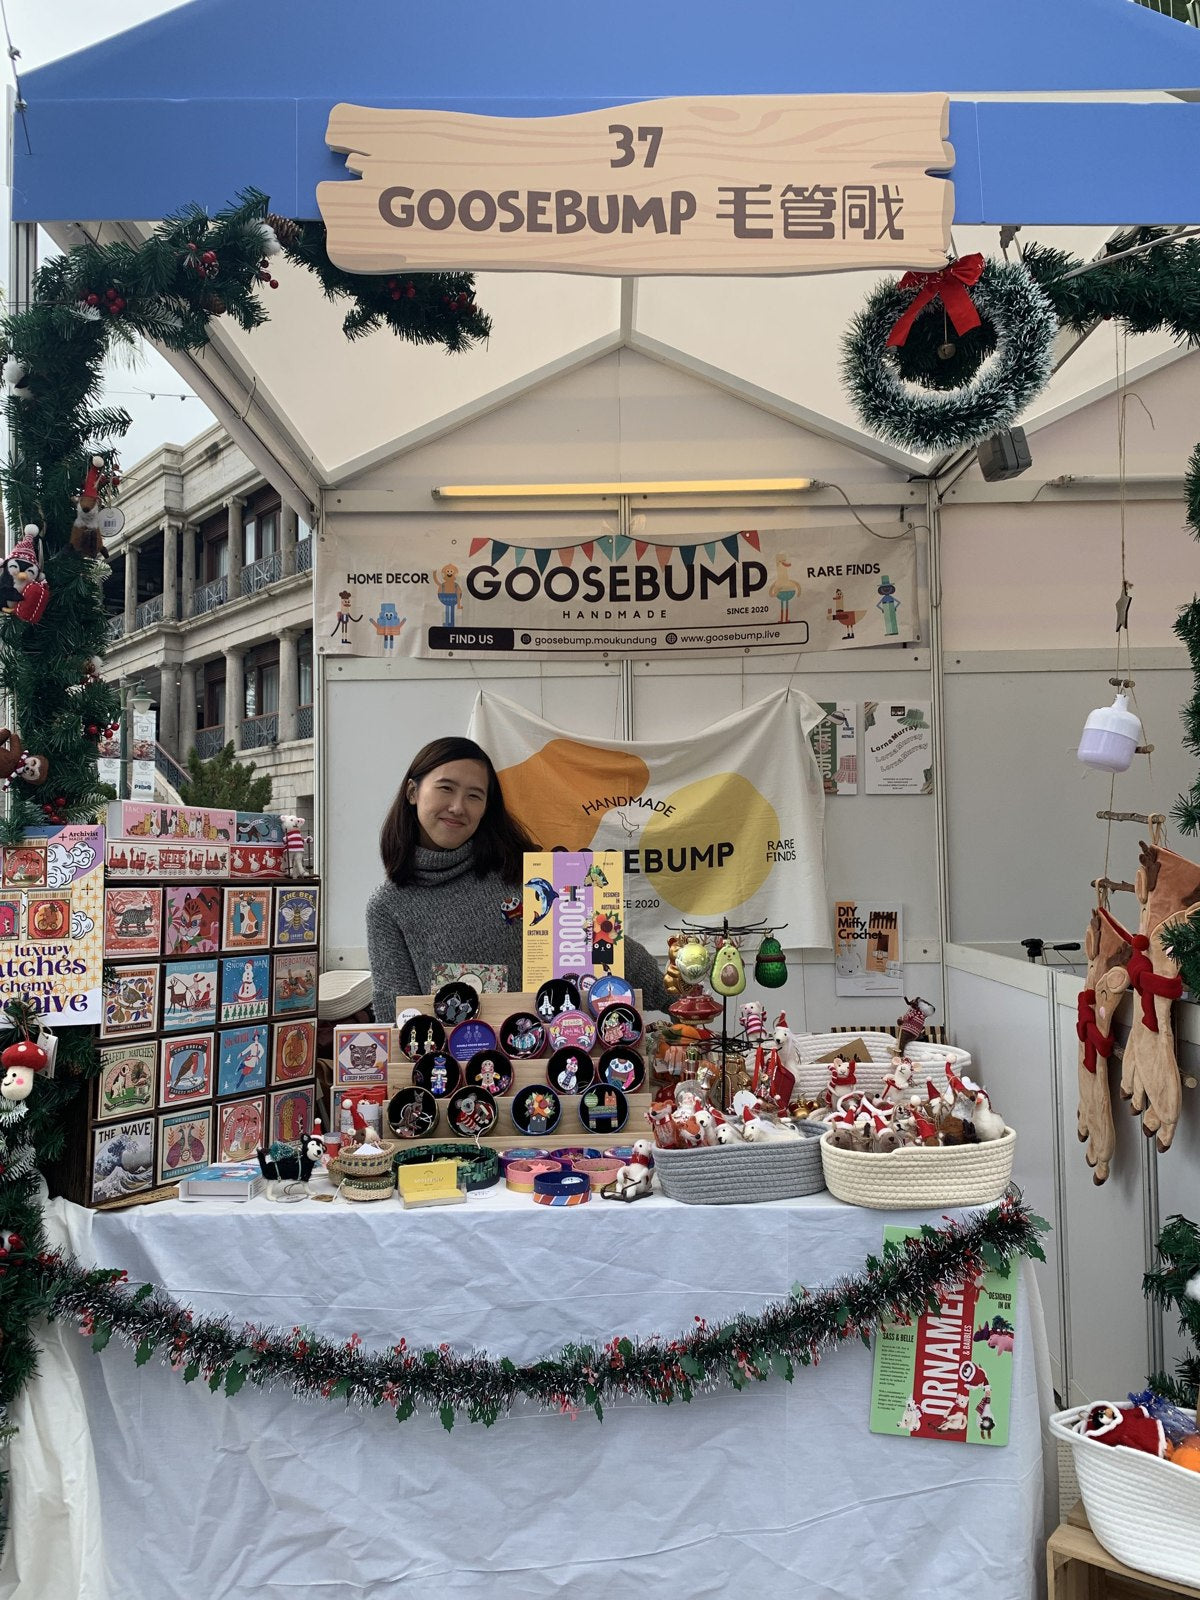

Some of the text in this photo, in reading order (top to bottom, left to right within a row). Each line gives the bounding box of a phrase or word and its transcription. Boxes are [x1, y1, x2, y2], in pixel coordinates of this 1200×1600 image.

[609, 124, 663, 168] 37
[378, 184, 904, 240] GOOSEBUMP 毛管戙
[807, 563, 881, 578] RARE FINDS
[347, 572, 430, 584] HOME DECOR
[466, 560, 768, 603] GOOSEBUMP
[563, 609, 667, 619] HANDMADE
[727, 606, 769, 615] SINCE 2020
[449, 634, 494, 645] FIND US
[535, 634, 657, 647] goosebump.moukundung
[681, 630, 780, 644] www.goosebump.live
[581, 796, 677, 818] HANDMADE
[767, 838, 795, 850] RARE
[550, 842, 735, 874] EBUMP
[766, 850, 797, 862] FINDS
[282, 891, 314, 901] THE BEE
[635, 900, 660, 909] 2020
[838, 906, 857, 917] DIY
[838, 917, 867, 931] Miffy
[838, 929, 882, 940] Crochet
[15, 945, 73, 959] luxury
[99, 1121, 151, 1143] THE WAVE
[989, 1291, 1011, 1302] DESIGNED
[998, 1301, 1011, 1310] IN UK
[882, 1332, 895, 1341] SASS
[900, 1334, 914, 1343] BELLE
[963, 1325, 972, 1349] BAUBLES
